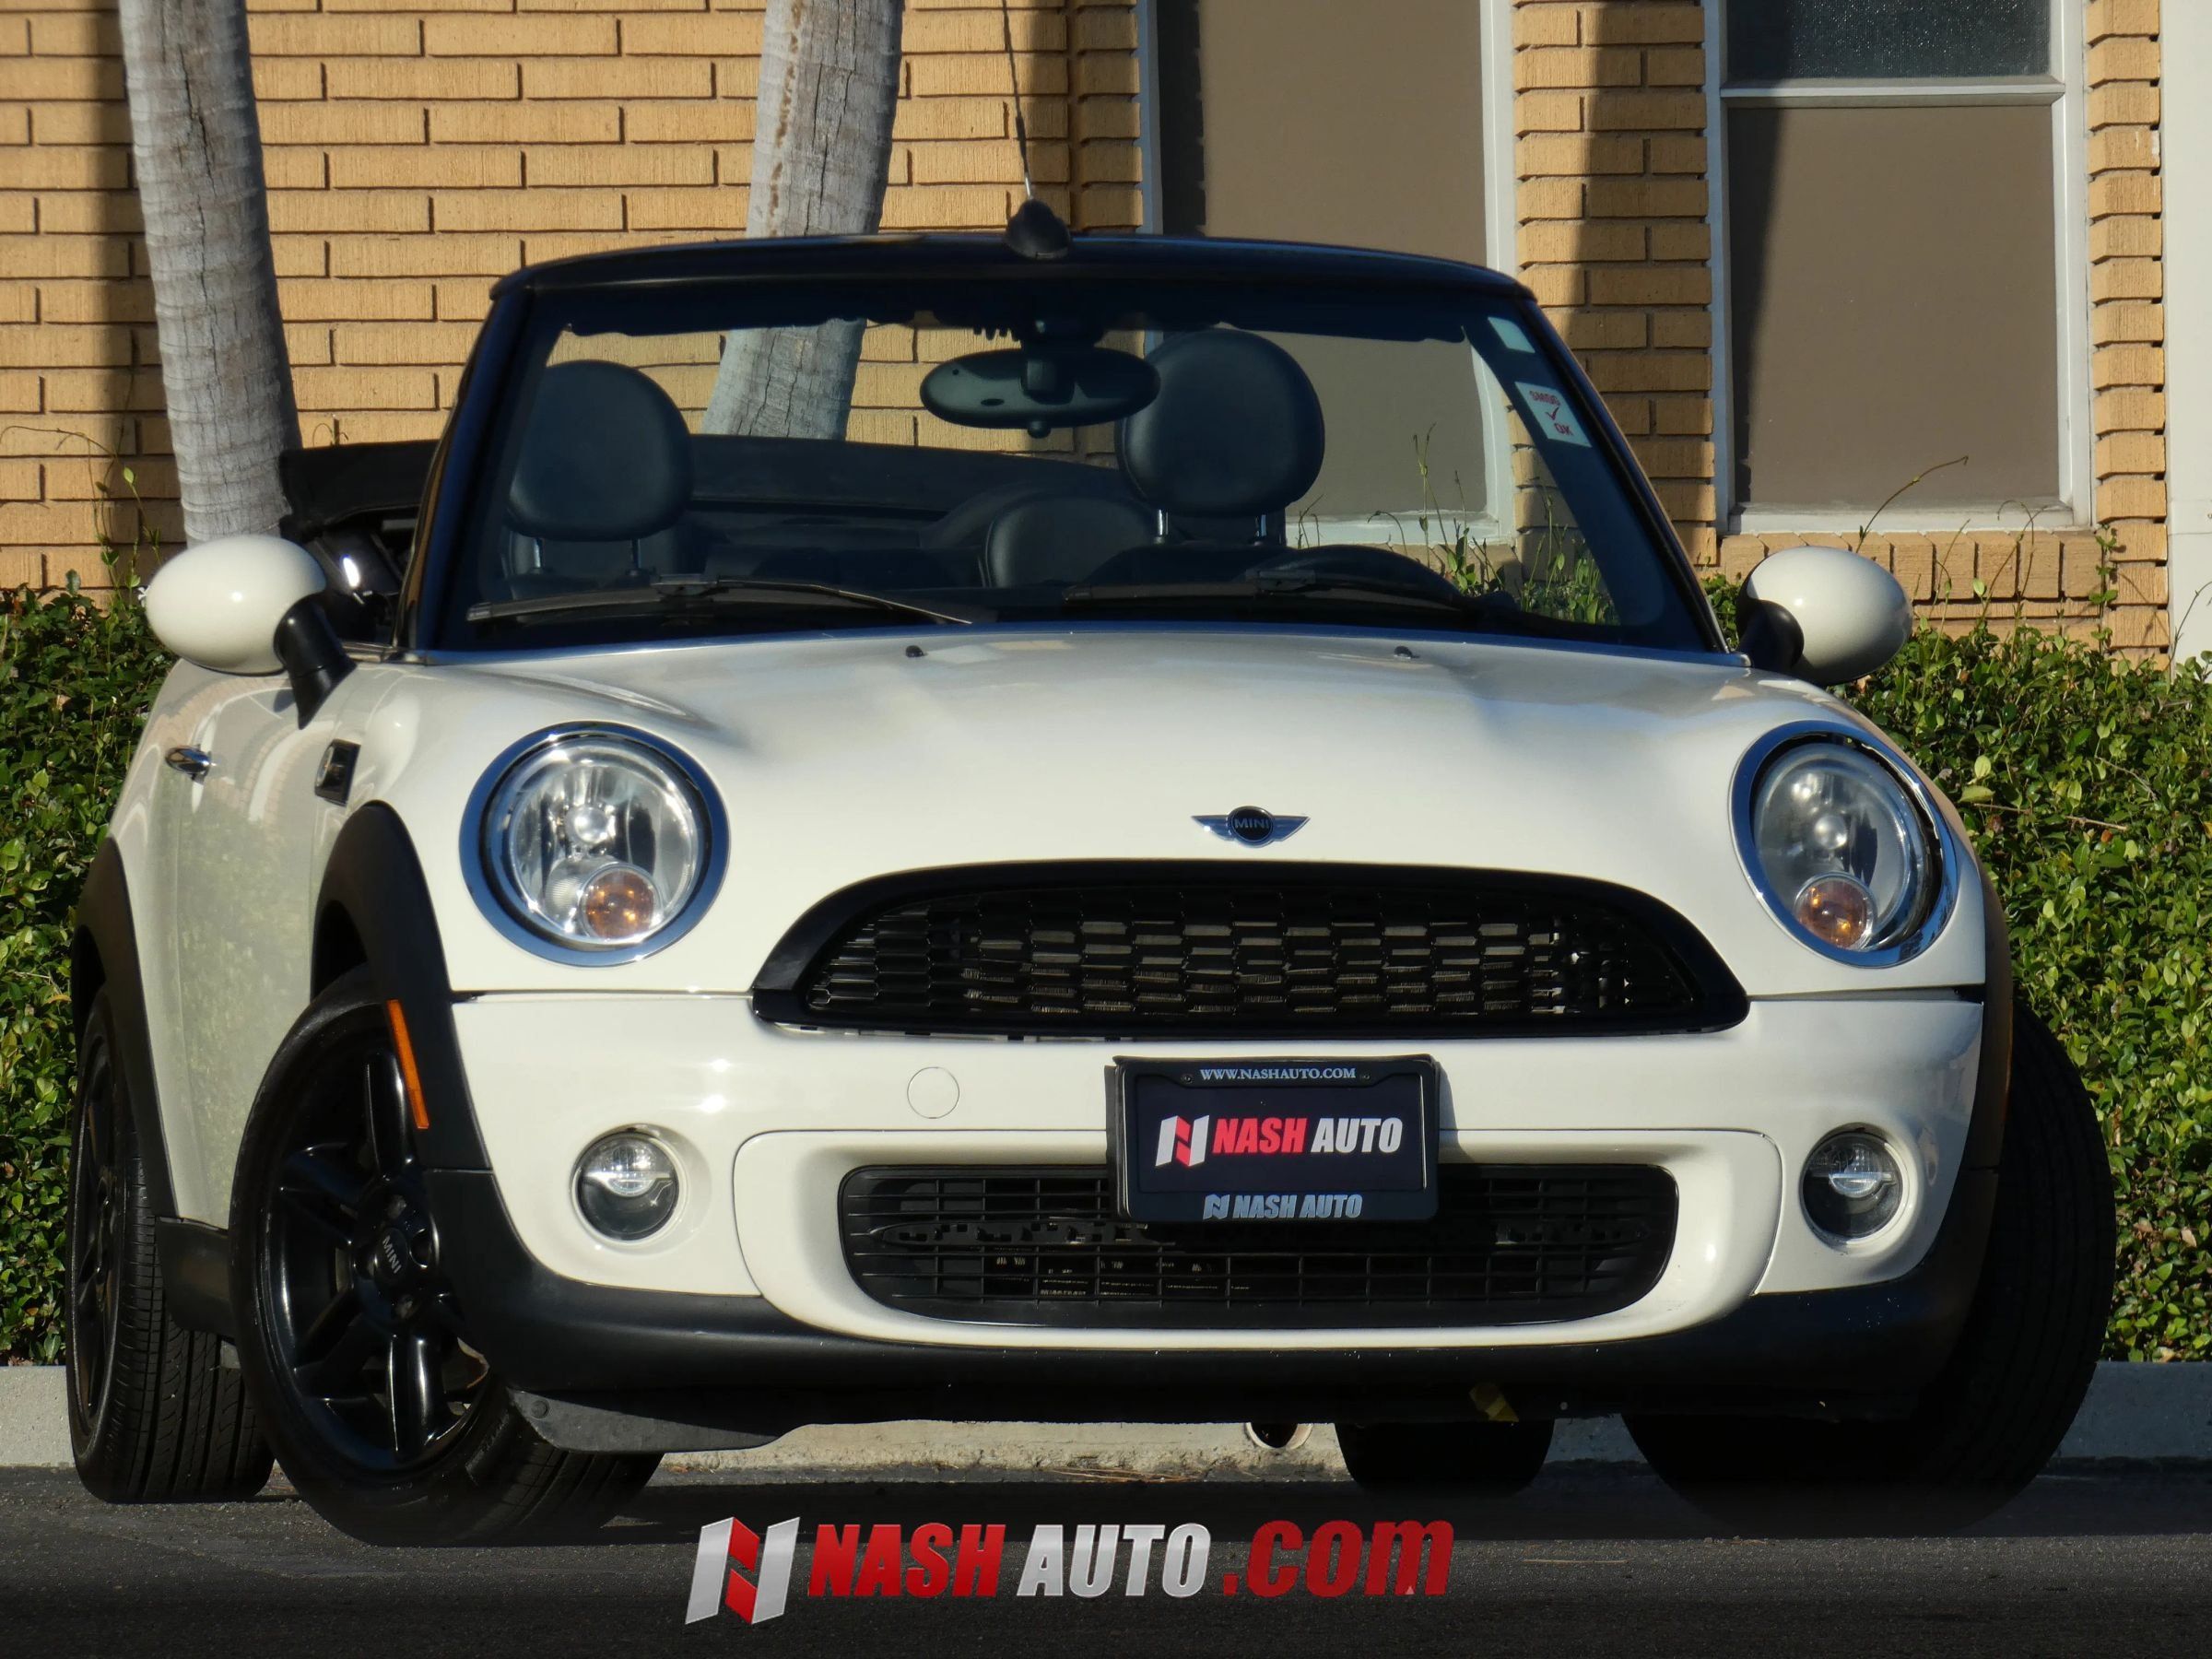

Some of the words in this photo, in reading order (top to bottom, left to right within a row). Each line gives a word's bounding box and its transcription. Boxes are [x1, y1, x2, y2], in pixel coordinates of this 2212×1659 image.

[1554, 422, 1574, 436] OK
[1235, 818, 1269, 829] MINI
[1200, 1067, 1356, 1080] WWW.NASHAUTO.COM
[1212, 1117, 1309, 1155] NASH
[1311, 1117, 1403, 1154] AUTO
[1232, 1194, 1296, 1218] NASH
[1299, 1194, 1363, 1218] AUTO
[382, 1235, 402, 1274] MINI
